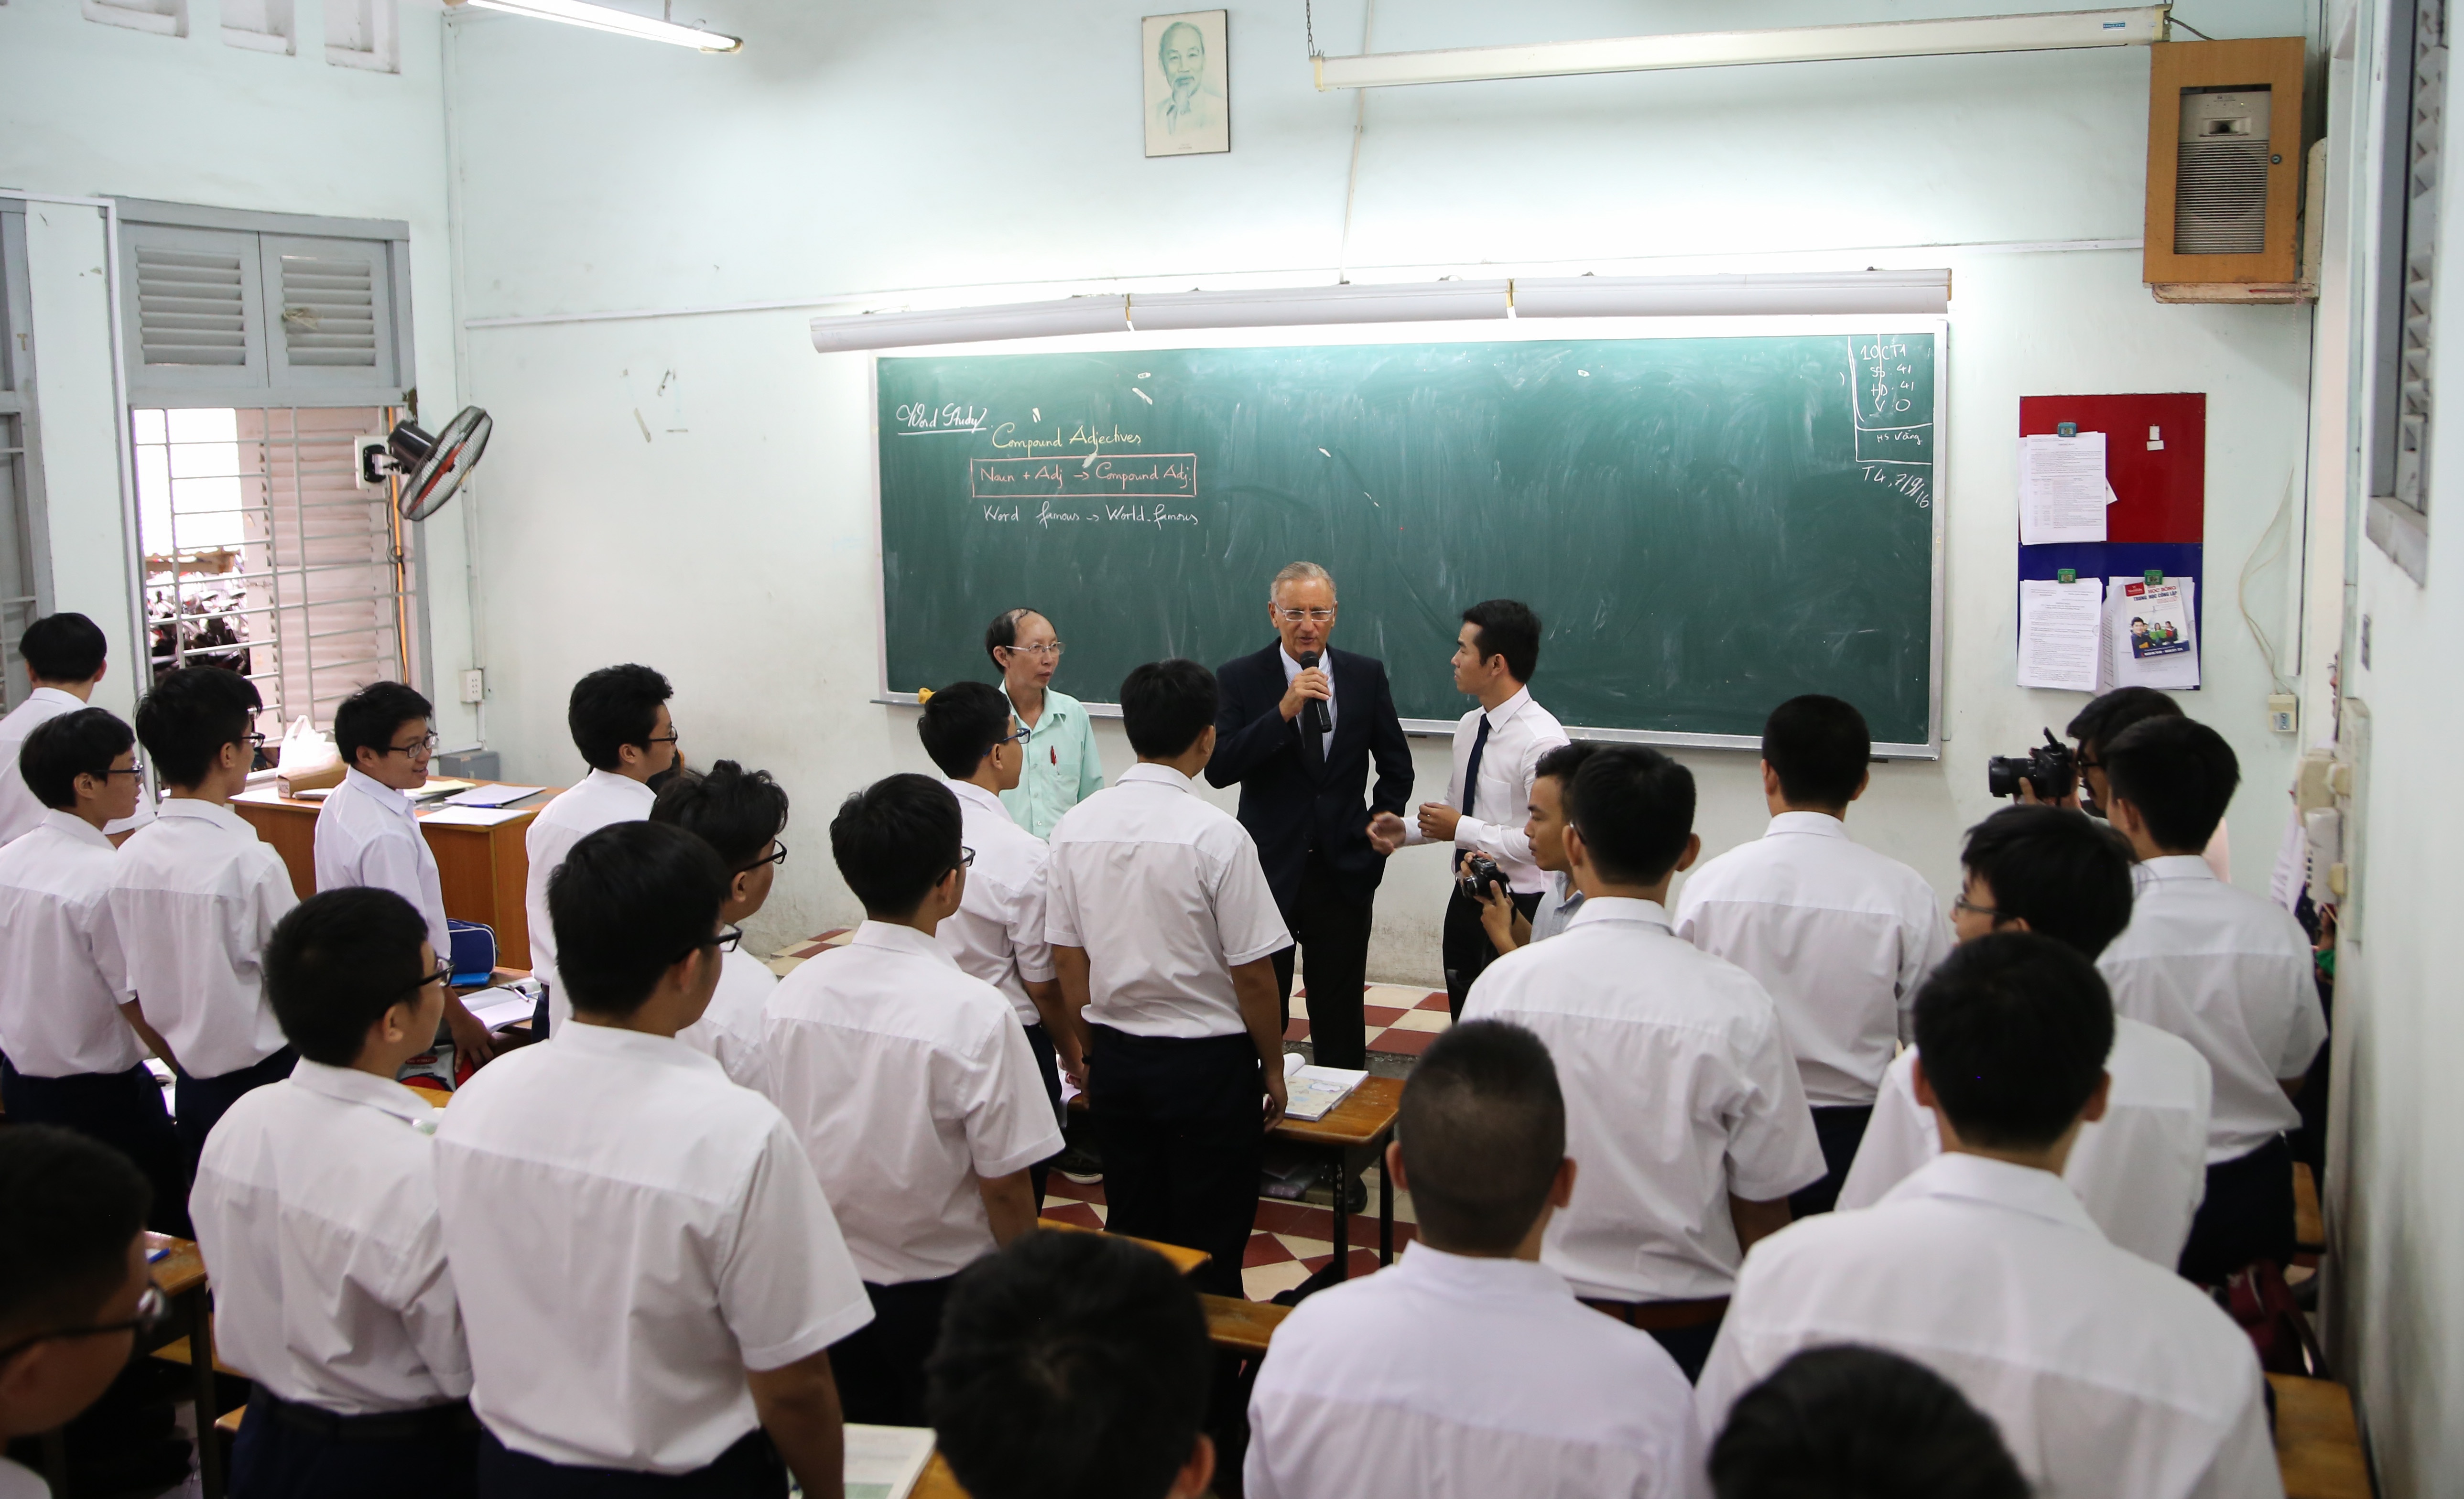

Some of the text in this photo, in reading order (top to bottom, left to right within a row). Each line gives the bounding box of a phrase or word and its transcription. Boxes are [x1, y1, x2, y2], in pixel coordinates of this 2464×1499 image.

[1860, 344, 1906, 360] 10CT1
[1896, 363, 1911, 374] 41
[1900, 380, 1914, 391] 41
[896, 402, 939, 428] Word
[992, 421, 1141, 458] Compound Adjectives
[1877, 432, 1889, 443] HS
[980, 466, 1015, 482] Noun
[1034, 464, 1063, 489] Adj
[1096, 461, 1159, 490] Compound
[983, 504, 1019, 522] Word
[1035, 501, 1080, 529] famous
